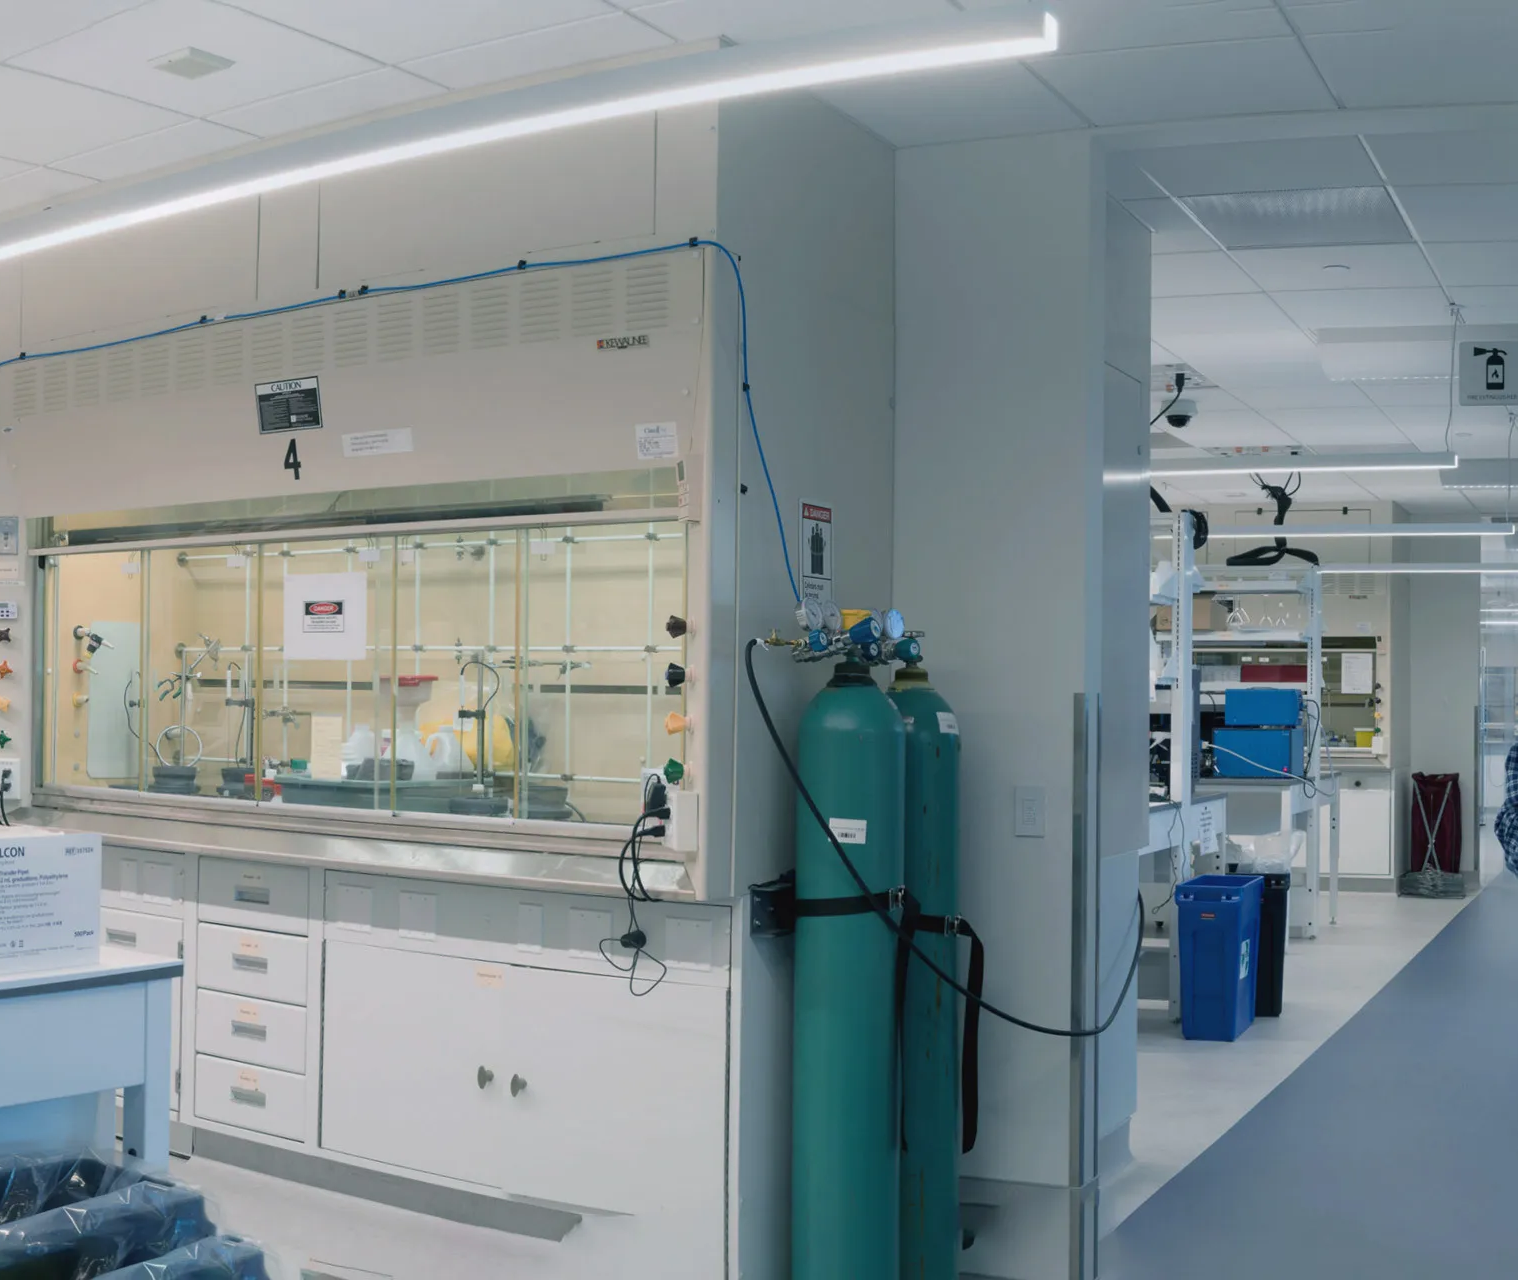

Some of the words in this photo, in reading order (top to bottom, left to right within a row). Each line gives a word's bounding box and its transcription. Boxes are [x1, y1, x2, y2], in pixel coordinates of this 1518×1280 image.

[605, 336, 647, 349] KEWAUNEE
[270, 381, 302, 392] CAUTION
[284, 438, 301, 480] 4
[810, 508, 830, 520] DANGER
